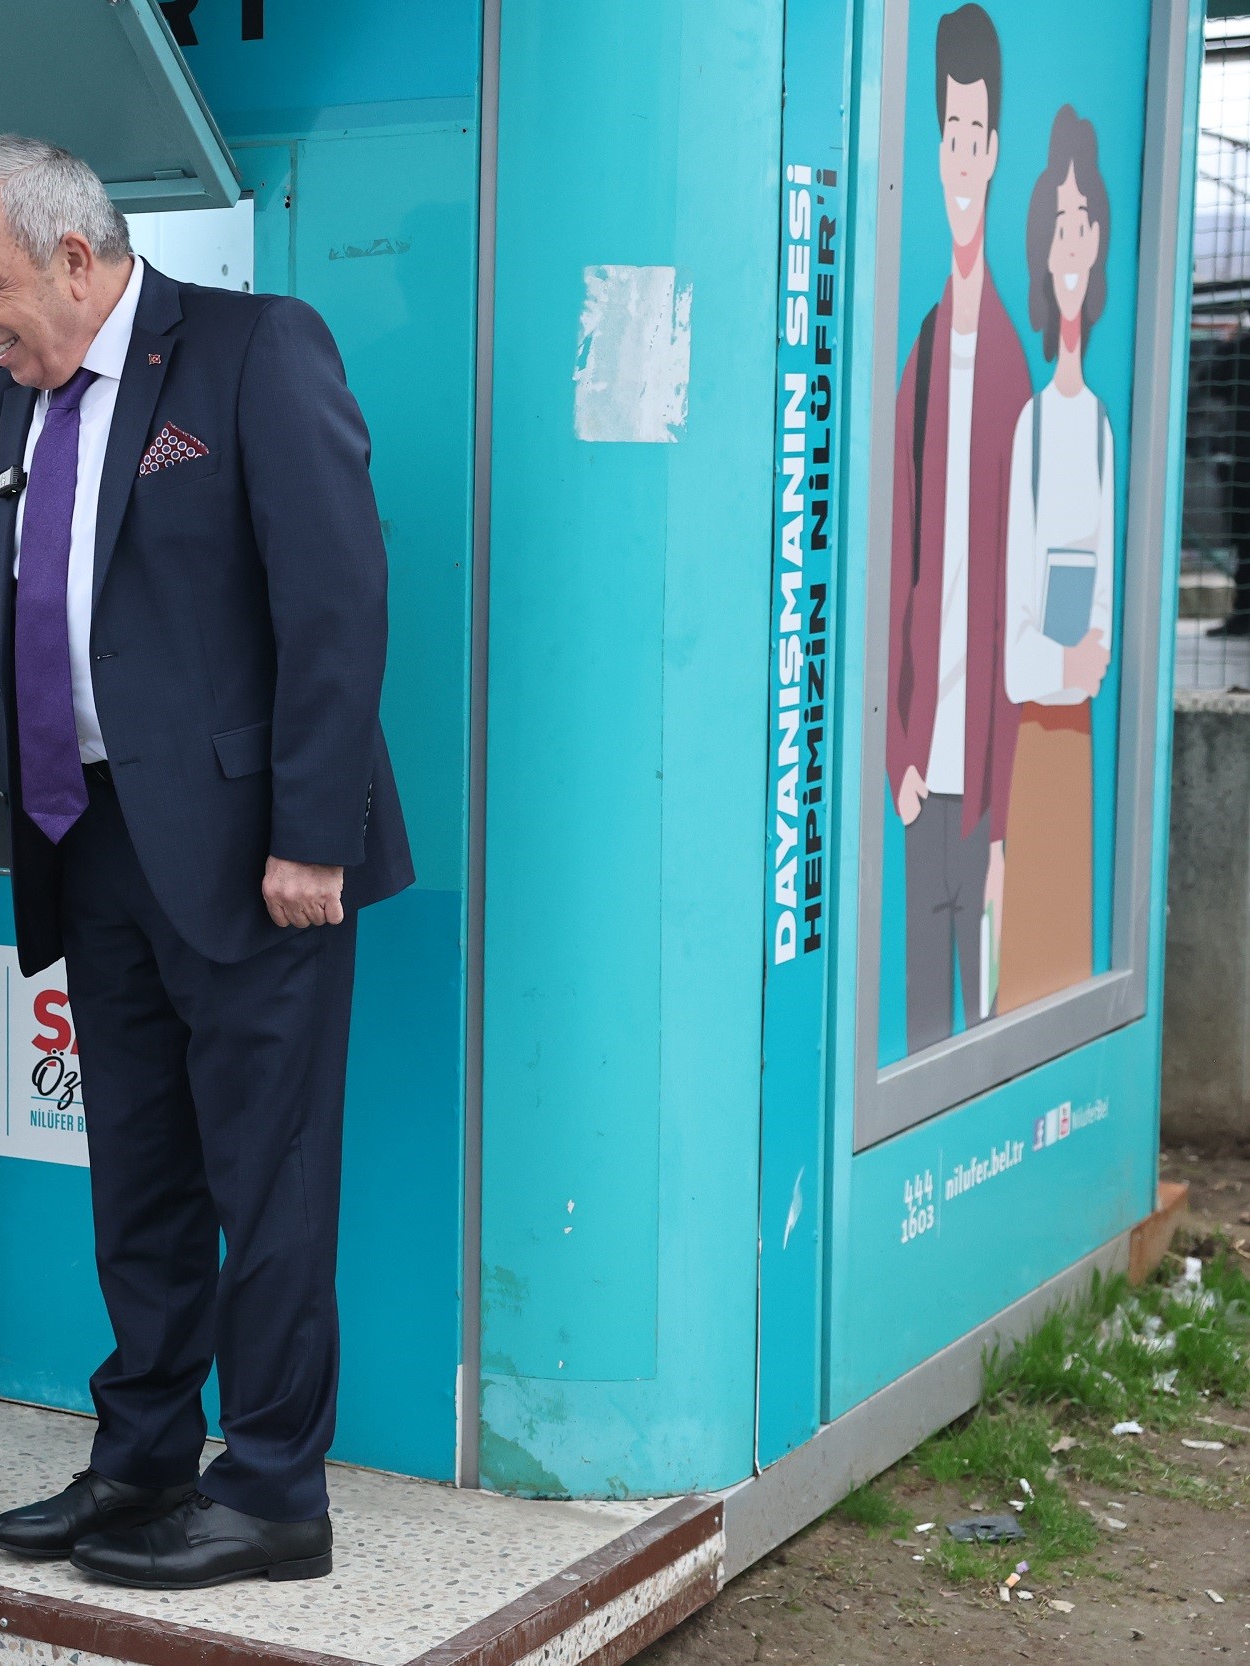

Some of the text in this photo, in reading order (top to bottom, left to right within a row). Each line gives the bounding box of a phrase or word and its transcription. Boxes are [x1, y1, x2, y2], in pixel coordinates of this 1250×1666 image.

[775, 164, 812, 965] DAYANIŞMANIN SESİ
[803, 583, 826, 953] HEPİMİZİN
[30, 1108, 88, 1133] NİLÜFER B
[903, 1168, 934, 1212] 444
[944, 1140, 1025, 1201] nilufer.bel.tr
[901, 1204, 934, 1244] 1603
